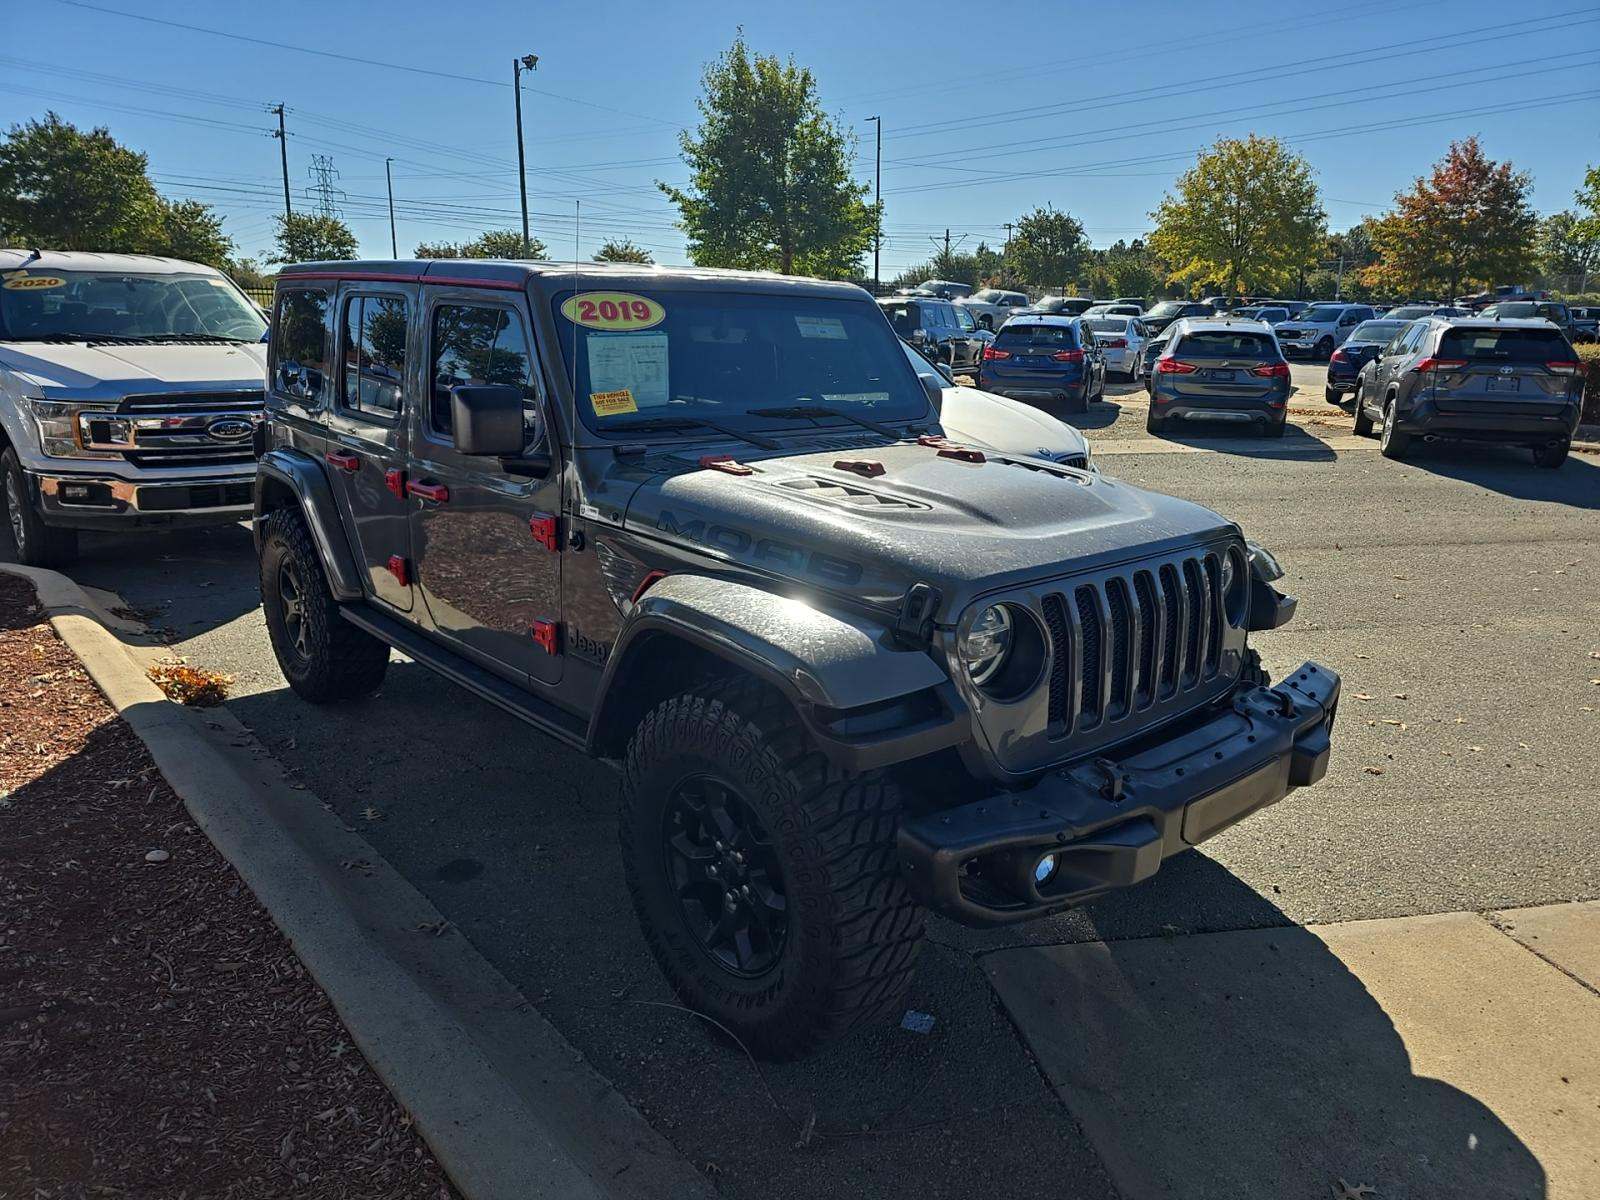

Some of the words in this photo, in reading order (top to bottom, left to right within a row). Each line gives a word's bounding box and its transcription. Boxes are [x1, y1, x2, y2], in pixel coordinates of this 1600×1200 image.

[11, 279, 58, 288] 2020
[578, 301, 651, 321] 2019
[656, 509, 864, 585] MOAB
[570, 628, 607, 662] Jeep
